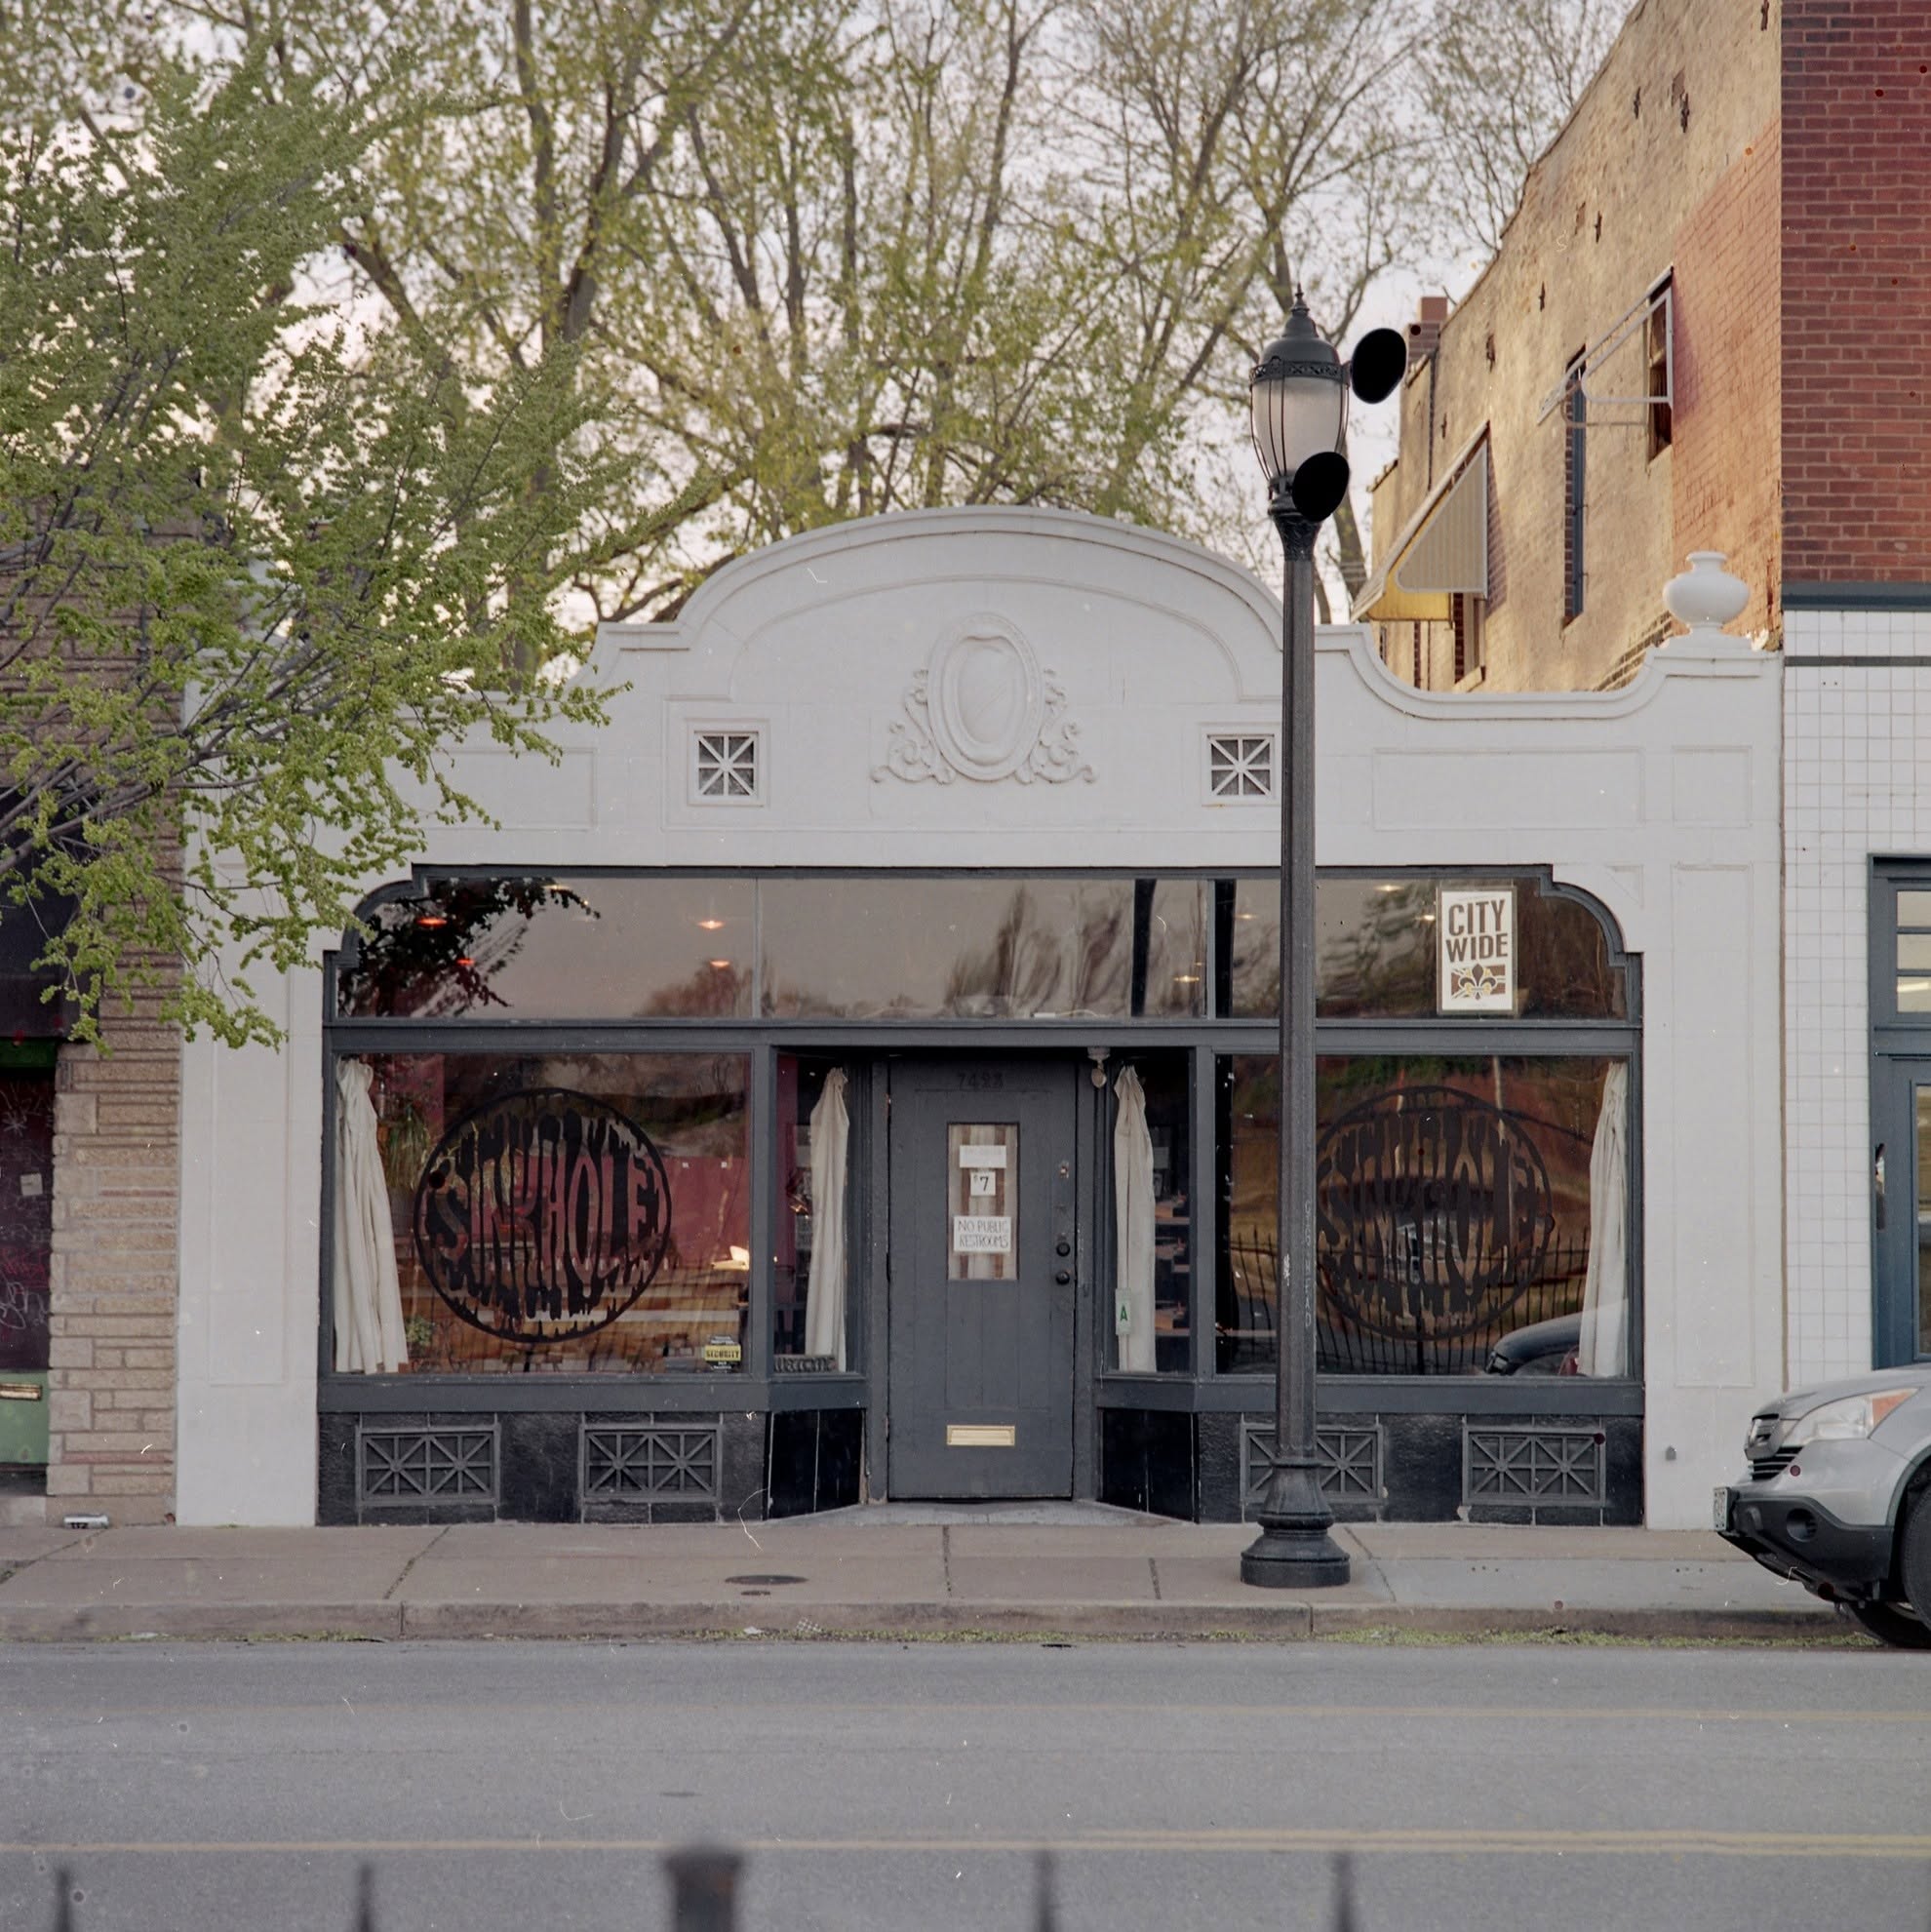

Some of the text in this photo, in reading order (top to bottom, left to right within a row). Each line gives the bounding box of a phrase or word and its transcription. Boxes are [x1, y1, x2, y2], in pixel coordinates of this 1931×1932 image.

[1448, 899, 1505, 936] CITY
[1445, 933, 1508, 963] WIDE
[425, 1108, 659, 1320] SINKHOLE
[958, 1220, 1008, 1234] NO PUBLIC
[960, 1234, 1008, 1248] RESTROOMS
[1120, 1305, 1128, 1321] A
[706, 1350, 739, 1359] SECURITY
